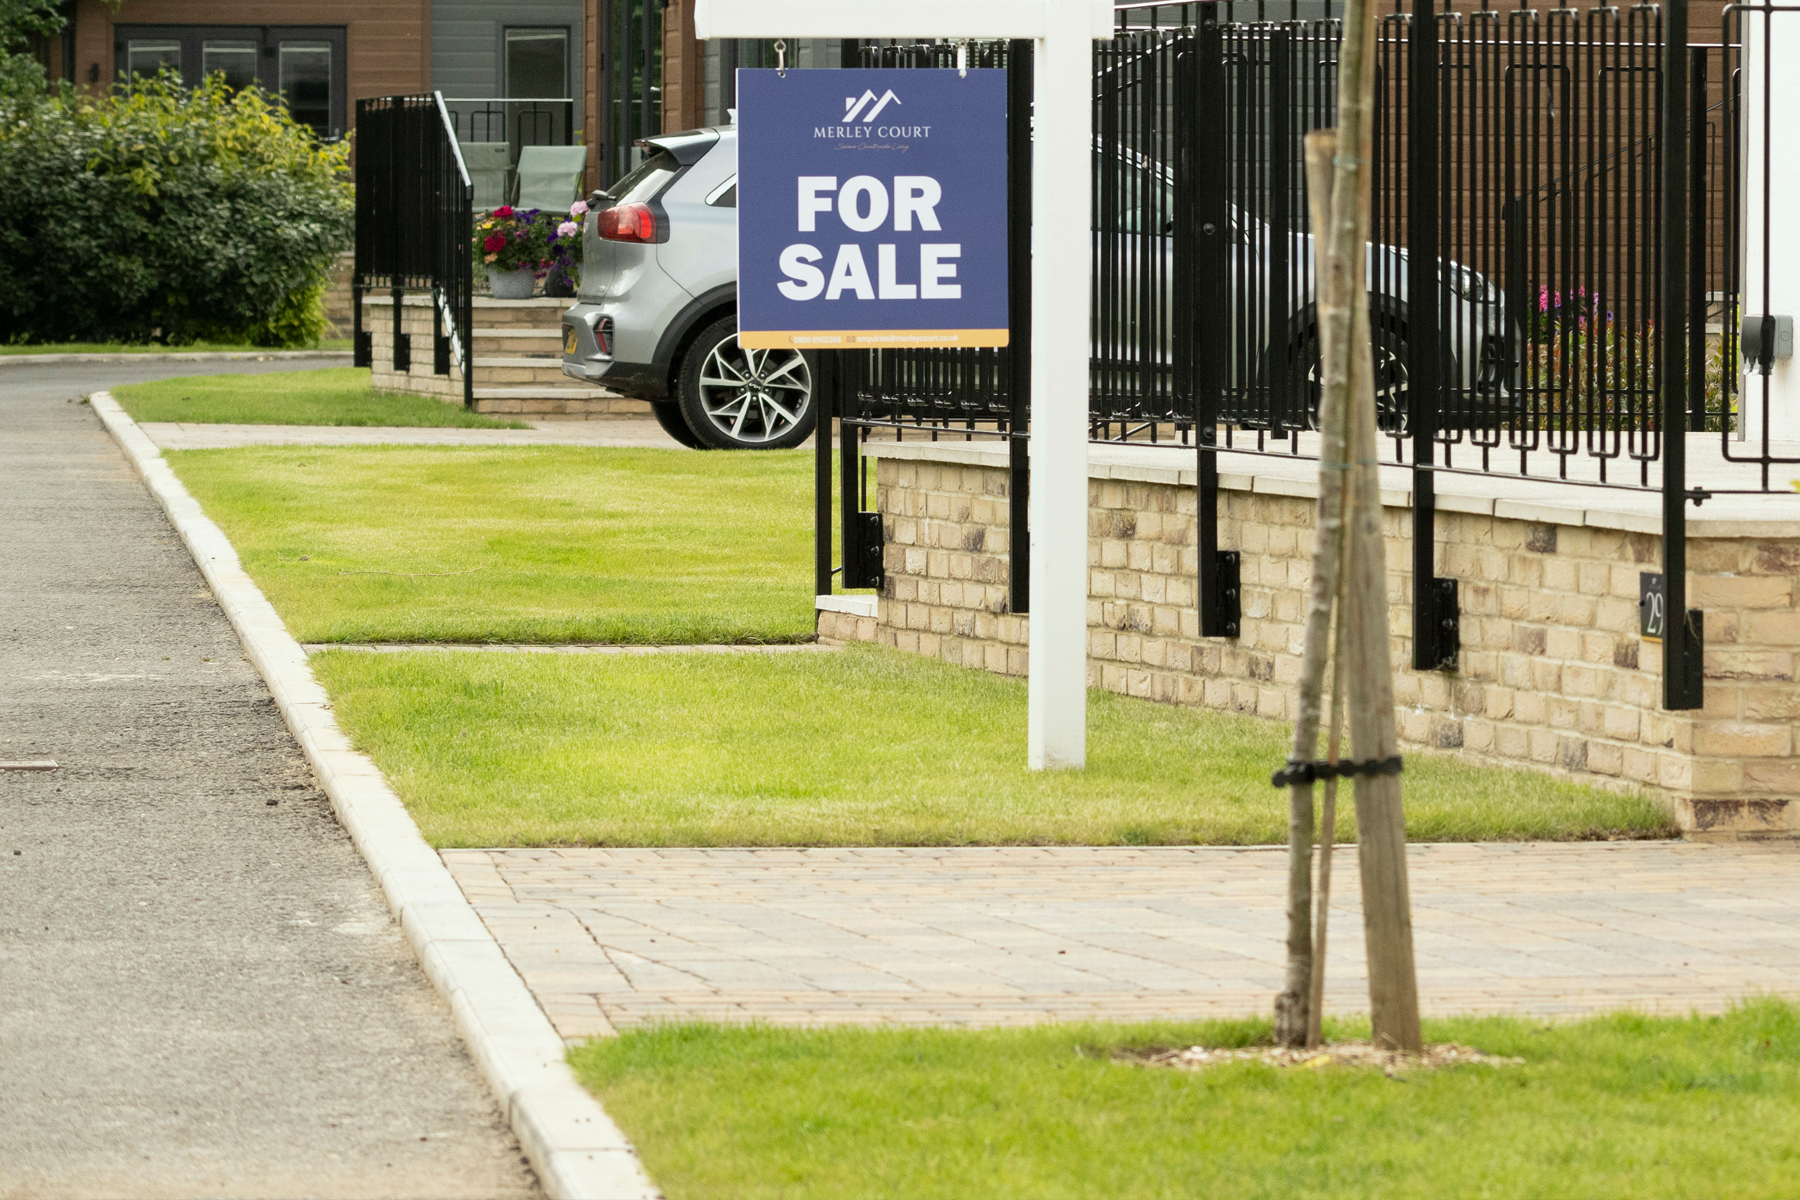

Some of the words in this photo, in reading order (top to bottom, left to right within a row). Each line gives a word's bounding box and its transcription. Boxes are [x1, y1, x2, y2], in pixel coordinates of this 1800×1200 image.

[813, 126, 872, 138] MERLEY
[877, 126, 931, 138] COURT
[798, 175, 942, 232] FOR
[777, 243, 962, 301] SALE
[793, 336, 811, 344] 0800
[857, 334, 959, 344] enquiries@merleycourt.co.uk
[1646, 591, 1664, 636] 29
